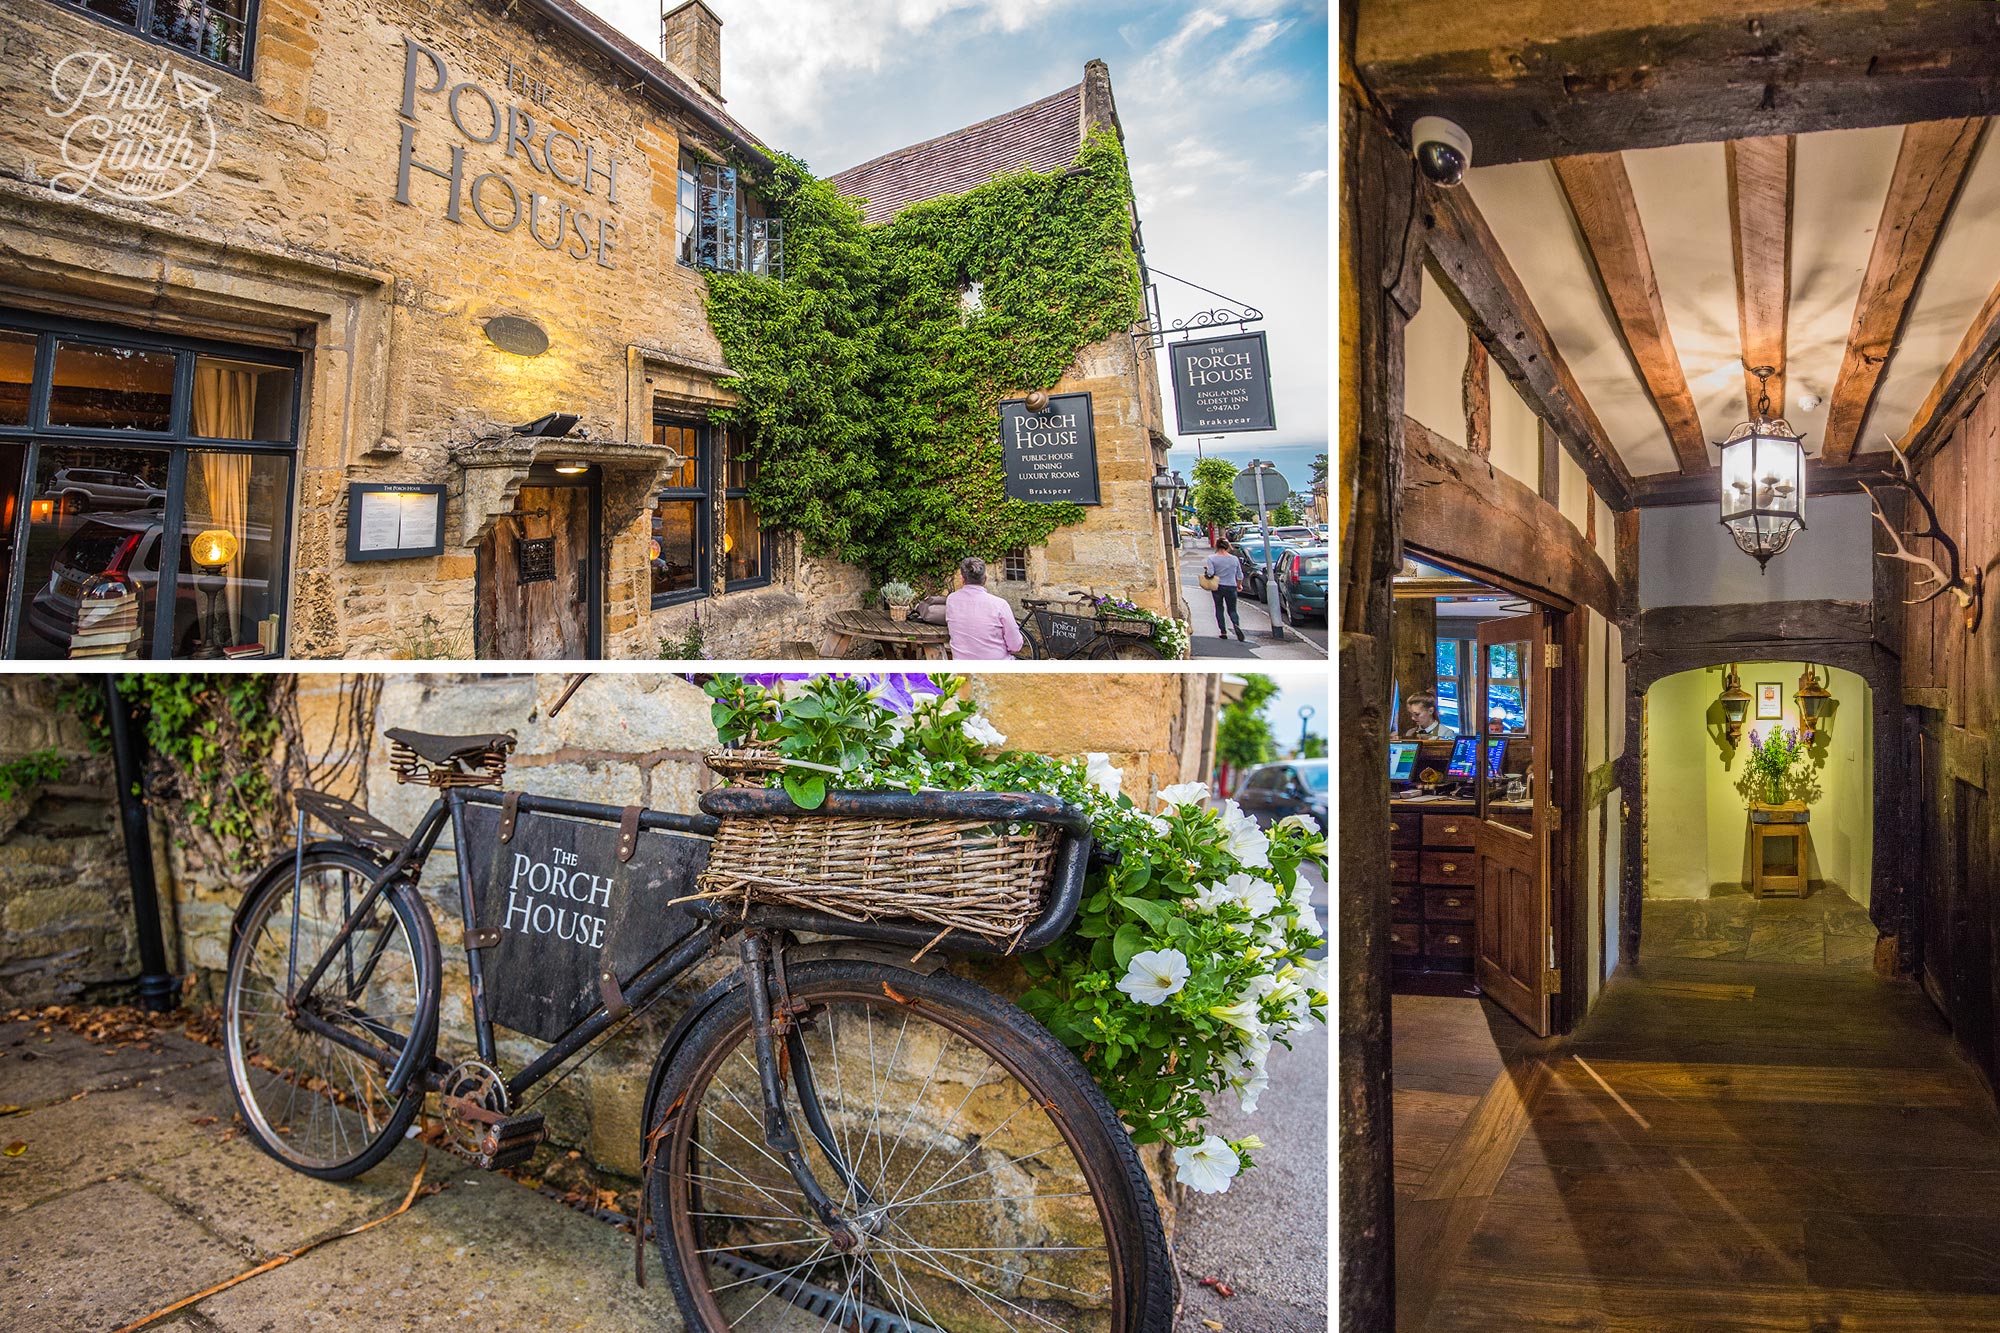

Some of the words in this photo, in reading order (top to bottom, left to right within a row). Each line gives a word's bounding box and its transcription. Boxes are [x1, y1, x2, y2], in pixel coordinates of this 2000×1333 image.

[501, 57, 552, 106] THE
[395, 33, 618, 204] PORCH
[392, 119, 617, 270] HOUSE
[1209, 347, 1225, 355] THE
[1187, 352, 1251, 372] PORCH
[1189, 368, 1253, 387] HOUSE
[1196, 397, 1228, 405] OLDEST
[1198, 388, 1246, 398] ENGLAND'S
[1206, 404, 1240, 412] c.947AD
[1014, 414, 1077, 433] PORCH
[1200, 417, 1251, 426] Brakspear
[1016, 431, 1078, 449] HOUSE
[1021, 454, 1047, 462] PUBLIC
[1051, 471, 1080, 479] ROOMS
[1052, 630, 1076, 639] HOUSE
[1053, 621, 1077, 632] PORCH
[552, 847, 579, 866] THE
[509, 853, 614, 908] PORCH
[503, 891, 606, 949] HOUSE
